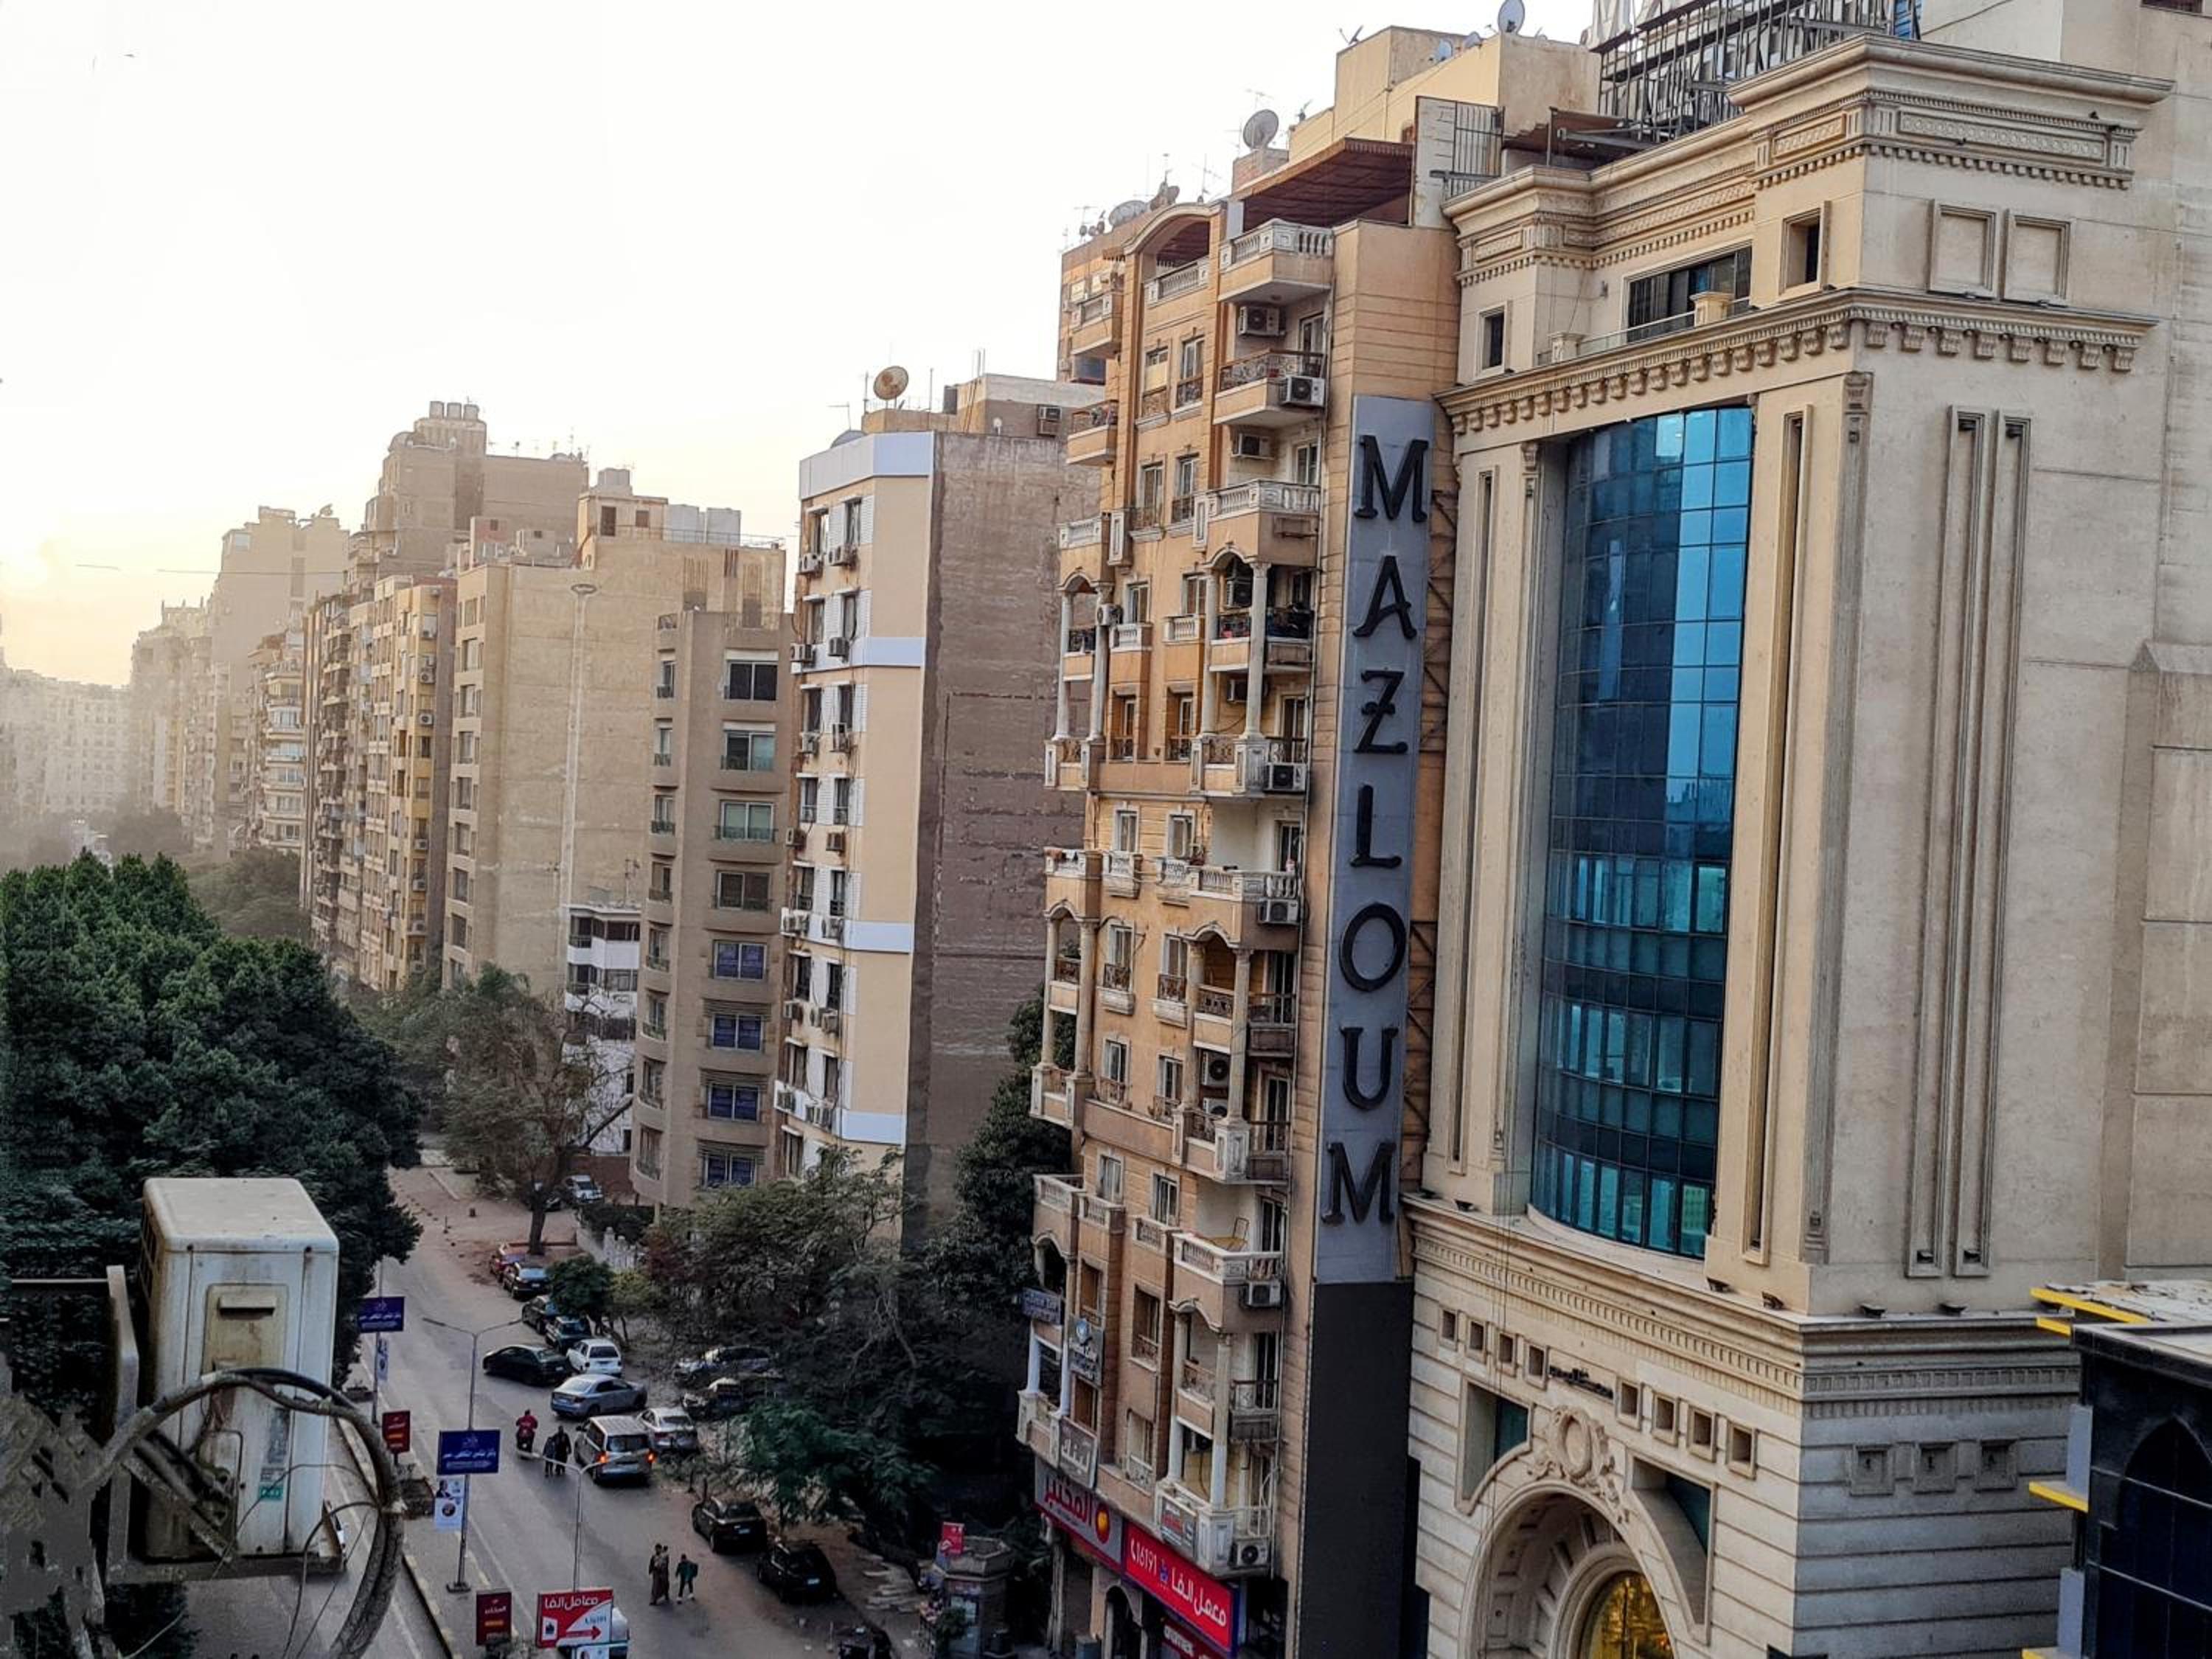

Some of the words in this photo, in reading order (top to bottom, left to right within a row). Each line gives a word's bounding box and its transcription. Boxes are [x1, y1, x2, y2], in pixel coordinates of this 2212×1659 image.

[1320, 434, 1428, 1224] MAZLOUM
[564, 1595, 598, 1611] معامل
[1194, 1587, 1226, 1627] معمل
